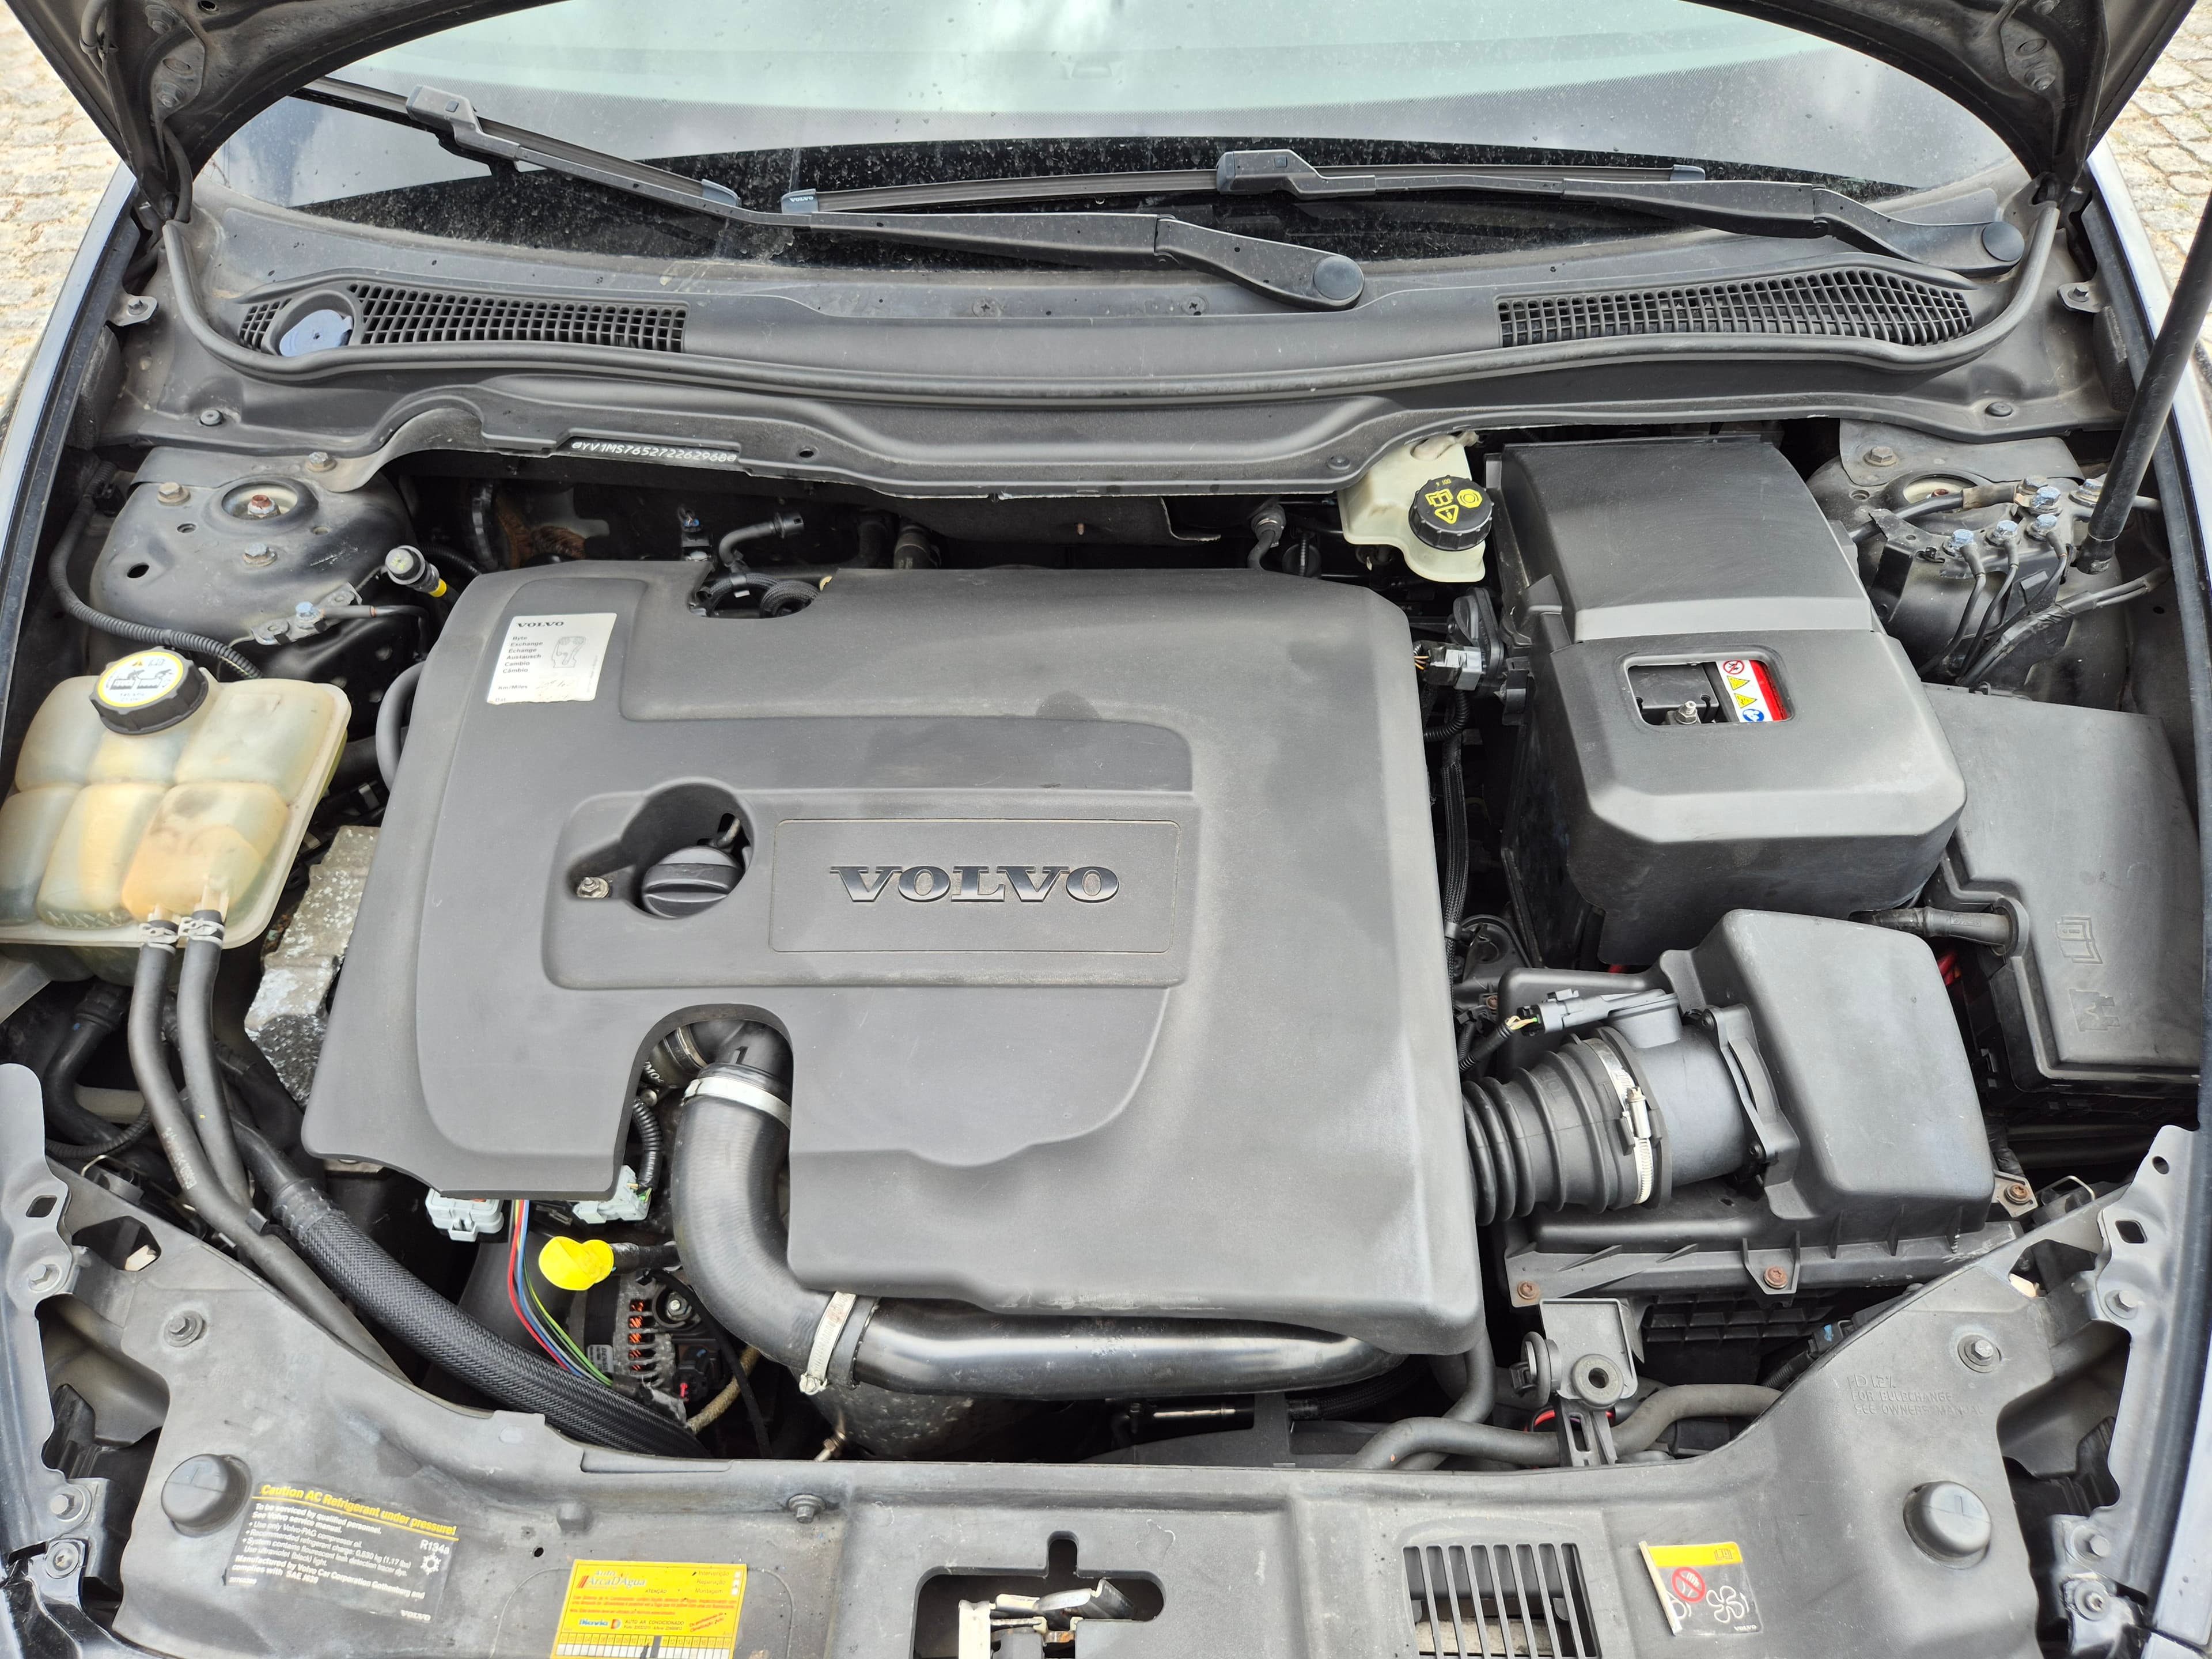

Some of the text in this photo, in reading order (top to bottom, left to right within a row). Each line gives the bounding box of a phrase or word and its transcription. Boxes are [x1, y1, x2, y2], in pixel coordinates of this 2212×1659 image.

[830, 865, 1120, 903] VOLVO
[1851, 1391, 1874, 1402] FOR
[1854, 1404, 1877, 1415] SEE
[261, 1484, 457, 1536] Caution AC Refrigerant under pressure!
[275, 1505, 307, 1516] serviced
[306, 1510, 316, 1519] by
[316, 1513, 347, 1525] qualified
[267, 1512, 289, 1521] Volvo
[289, 1516, 315, 1527] service
[268, 1522, 282, 1531] only
[283, 1524, 317, 1537] Volvo-PAG
[317, 1533, 354, 1546] compressor
[244, 1546, 257, 1554] Use
[257, 1547, 290, 1558] ultraviolet
[291, 1551, 313, 1563] (black)
[247, 1537, 271, 1546] System
[271, 1541, 301, 1551] contains
[335, 1554, 349, 1563] leak
[349, 1557, 377, 1570] detection
[249, 1529, 300, 1542] Recommended
[300, 1537, 332, 1550] refrigerant
[374, 1554, 383, 1563] kg
[419, 1539, 450, 1555] R134a
[232, 1564, 266, 1574] complies
[266, 1567, 283, 1576] with
[286, 1570, 303, 1580] SAE
[234, 1555, 426, 1600] Manufactured by Volvo Car Corporation Gothenburg and
[400, 1609, 432, 1623] VOLVO
